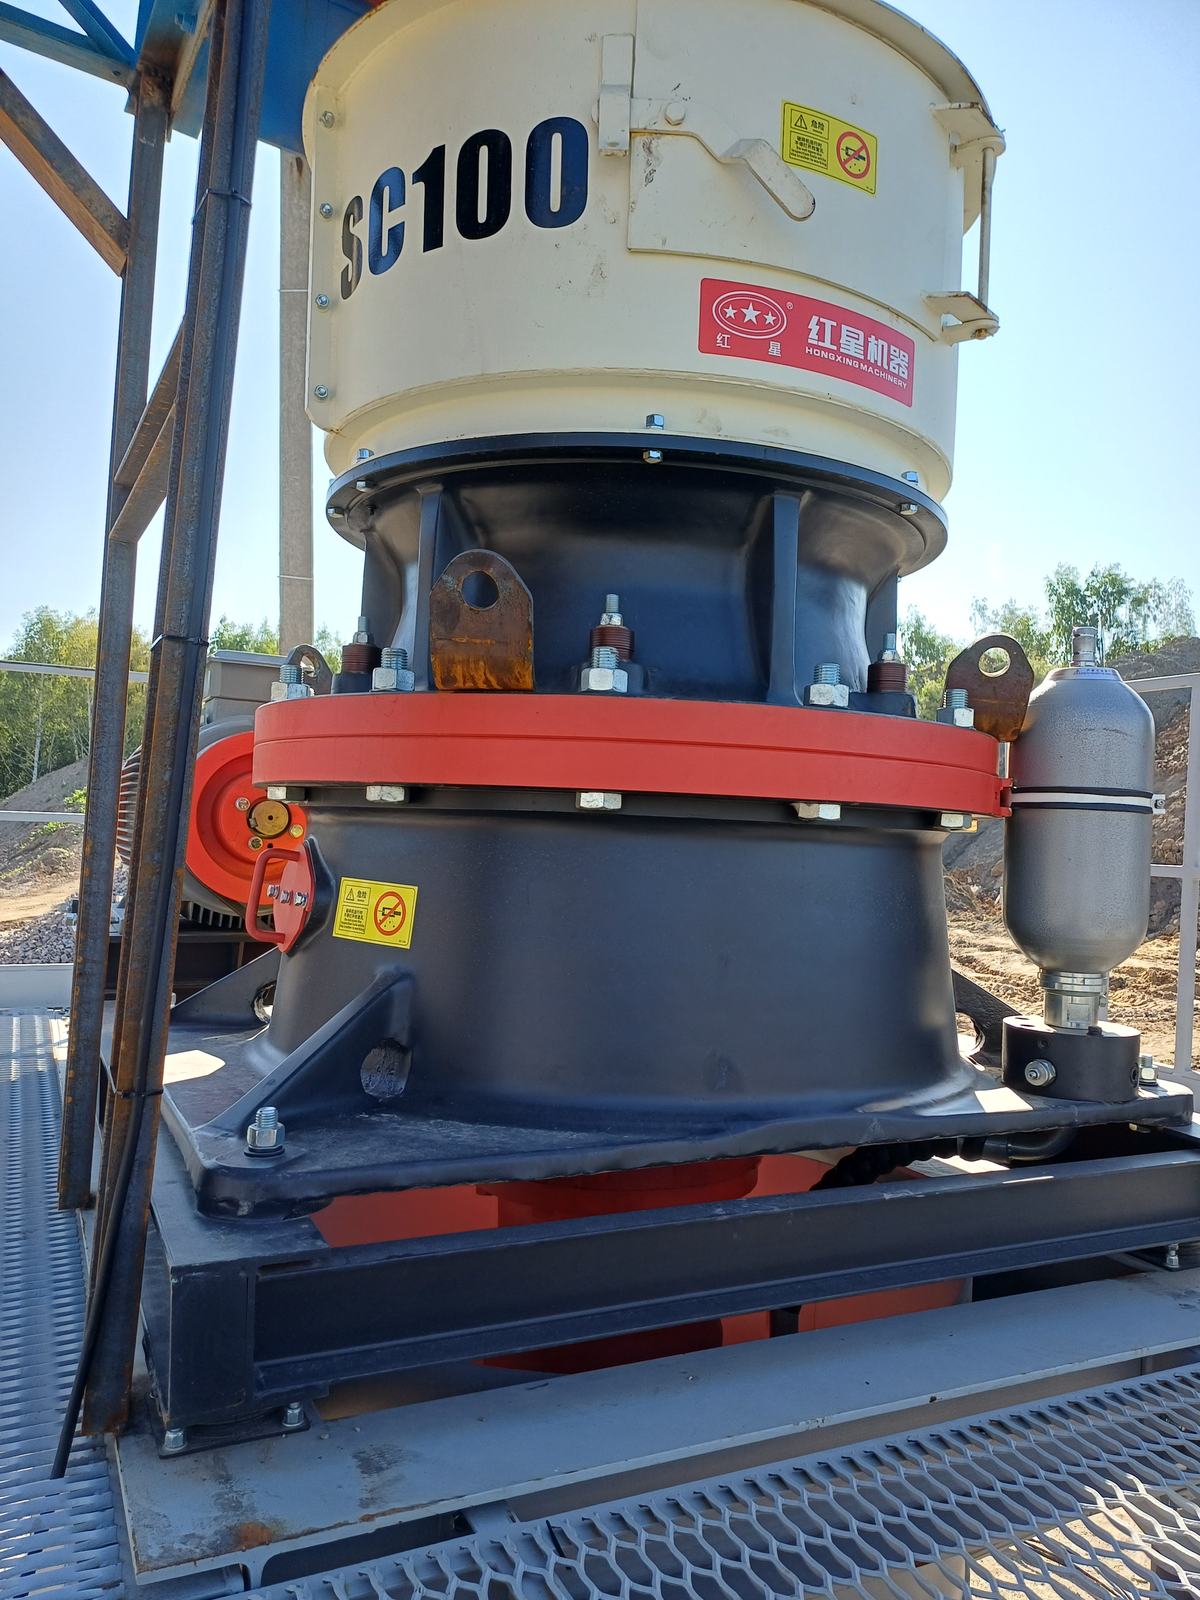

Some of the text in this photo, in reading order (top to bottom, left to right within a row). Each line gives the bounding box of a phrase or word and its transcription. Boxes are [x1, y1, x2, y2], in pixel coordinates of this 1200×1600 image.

[341, 116, 589, 300] SC100
[716, 332, 781, 357] 红 星
[806, 346, 907, 389] HONGXING MACHINERY
[807, 315, 909, 379] 红星机器
